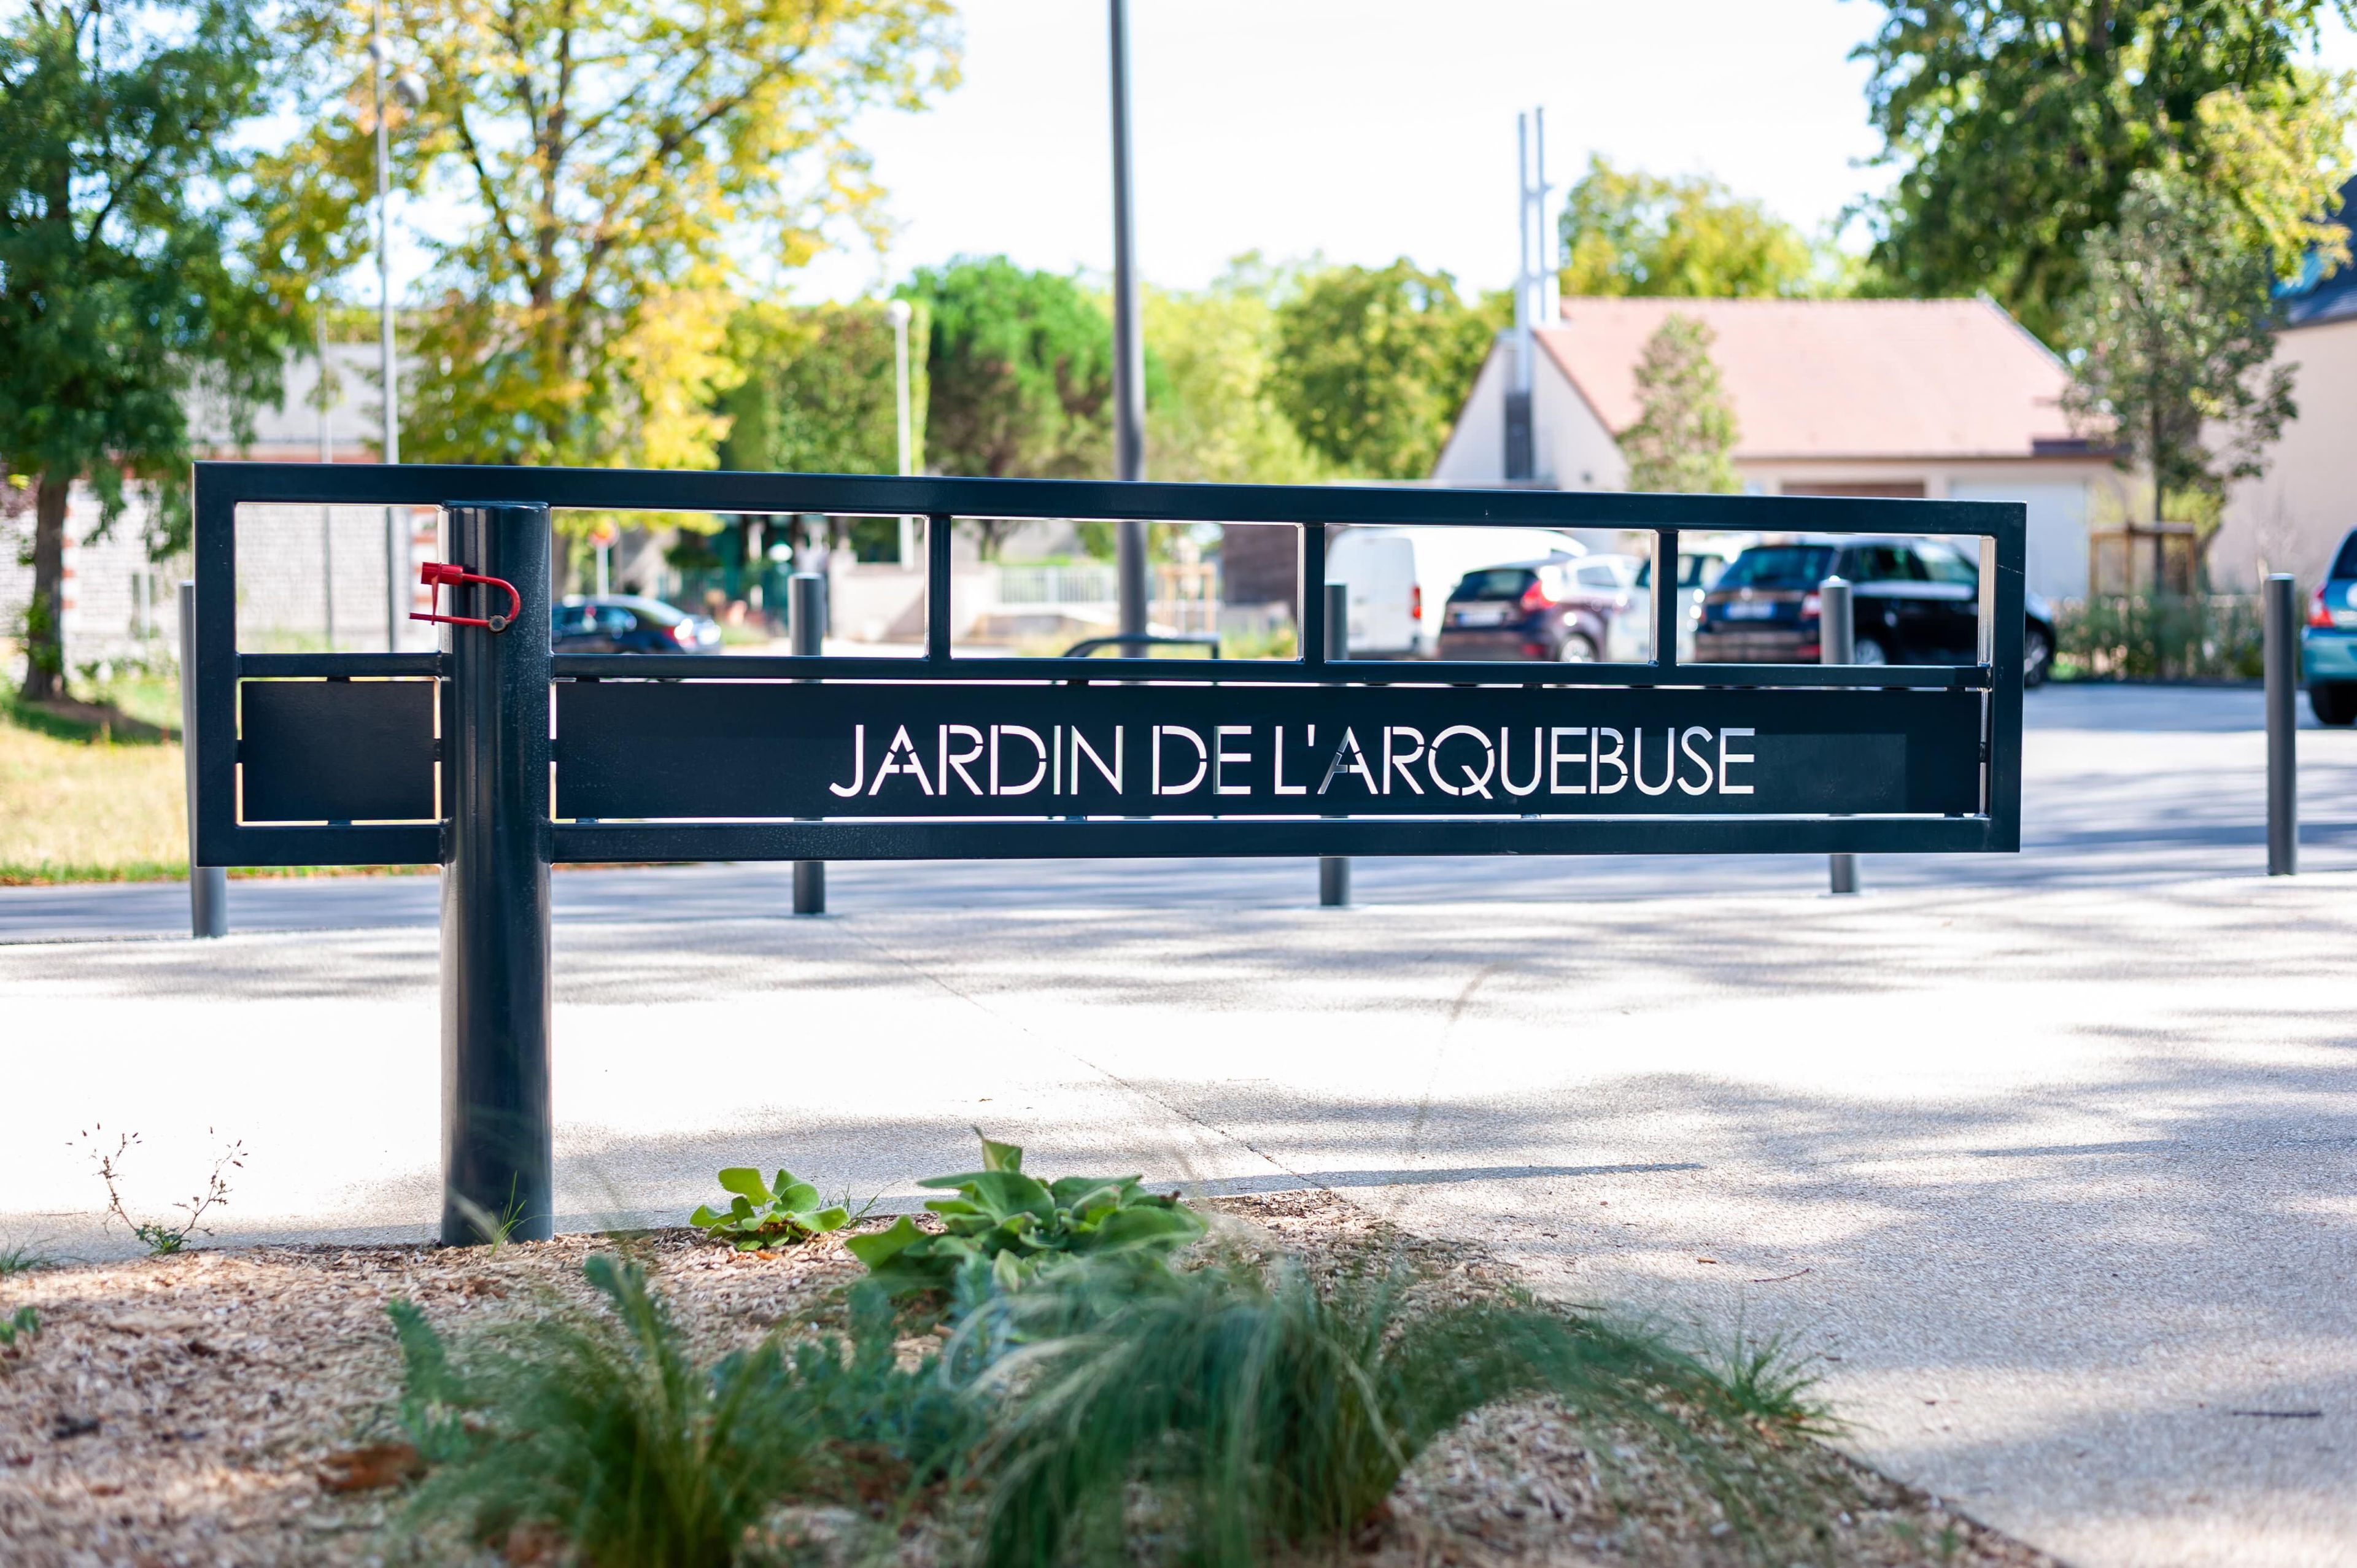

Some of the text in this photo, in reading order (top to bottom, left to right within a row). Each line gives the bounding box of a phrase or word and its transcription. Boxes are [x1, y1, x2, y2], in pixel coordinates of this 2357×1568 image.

[829, 724, 1755, 799] JARDIN DE L'ARQUEBUSE
